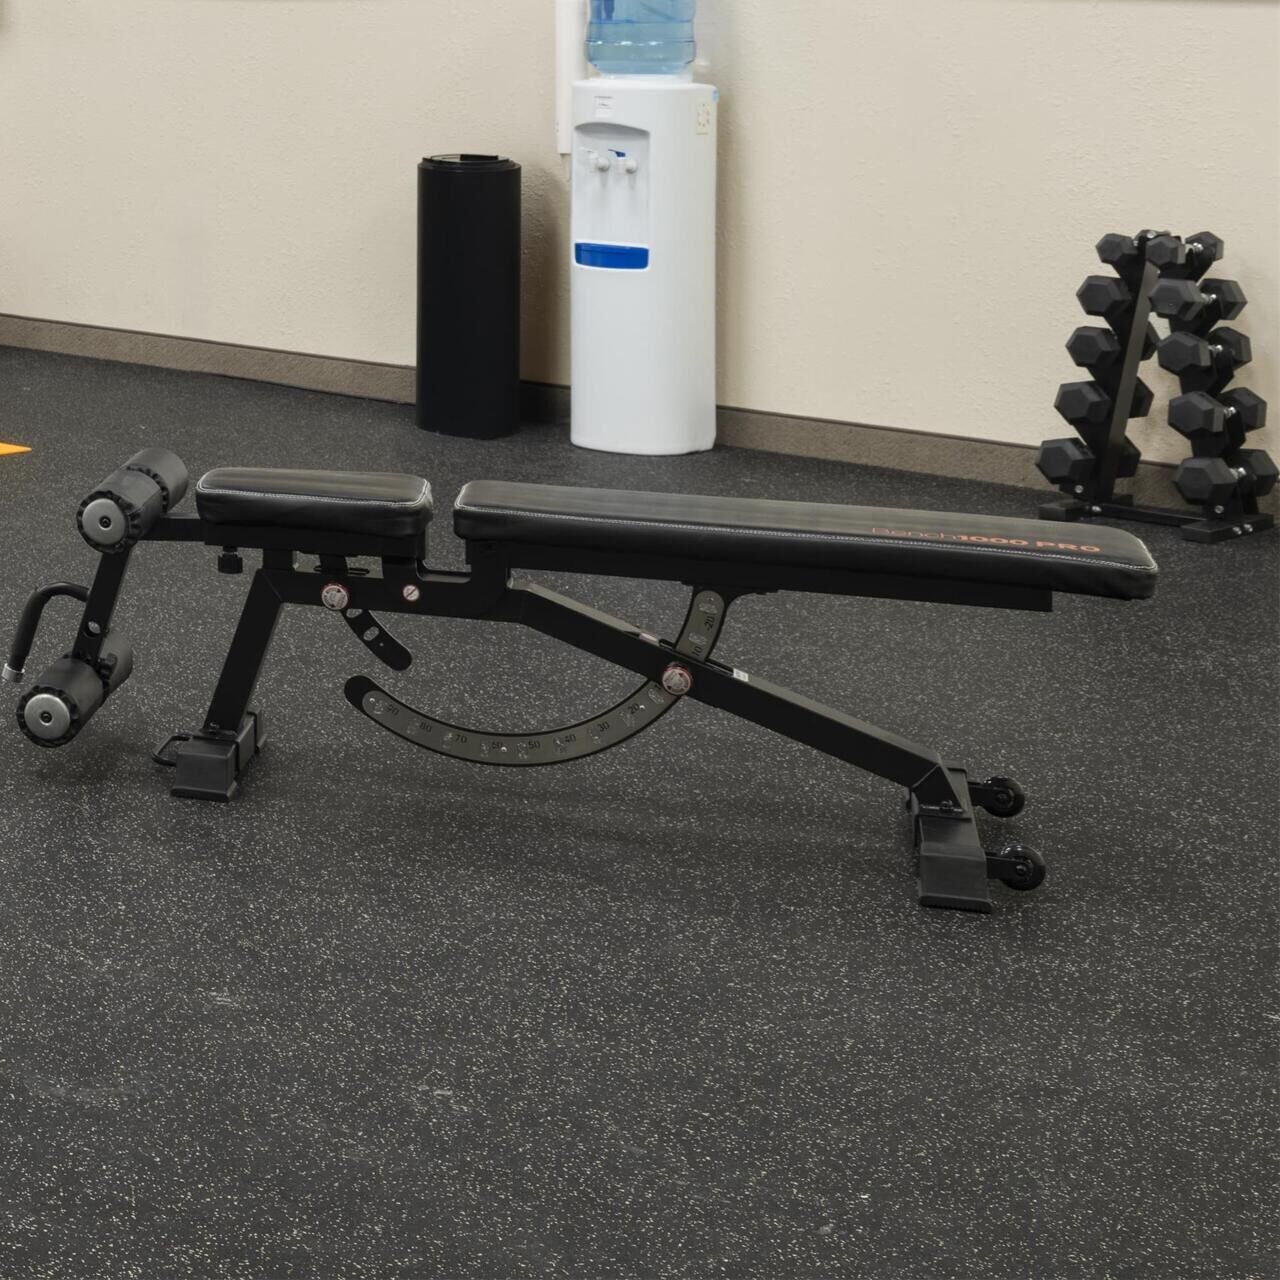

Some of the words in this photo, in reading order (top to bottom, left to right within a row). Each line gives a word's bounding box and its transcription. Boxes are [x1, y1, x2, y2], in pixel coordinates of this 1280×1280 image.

[1036, 540, 1101, 553] PRO
[454, 734, 468, 744] 70
[597, 721, 610, 732] 30
